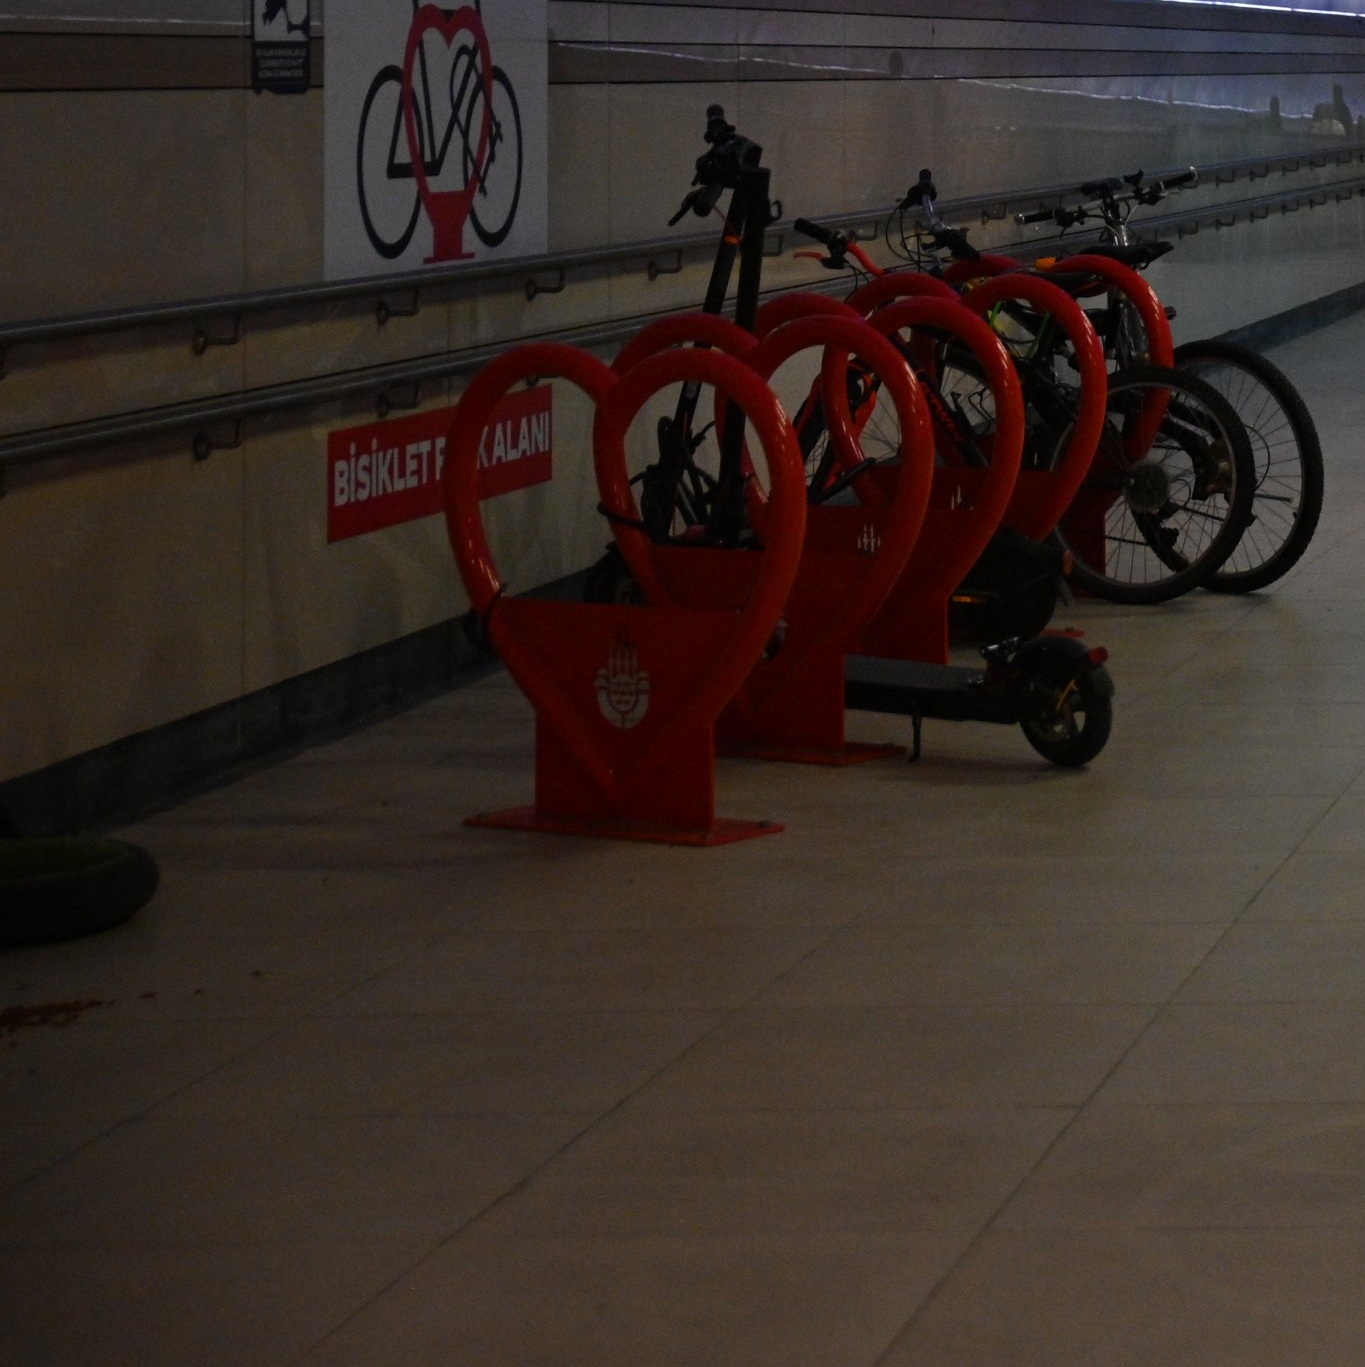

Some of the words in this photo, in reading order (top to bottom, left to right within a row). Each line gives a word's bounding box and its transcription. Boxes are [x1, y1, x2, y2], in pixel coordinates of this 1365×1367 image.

[334, 437, 431, 507] BİSİKLET
[435, 425, 489, 481] PK
[492, 411, 549, 466] ALANI
